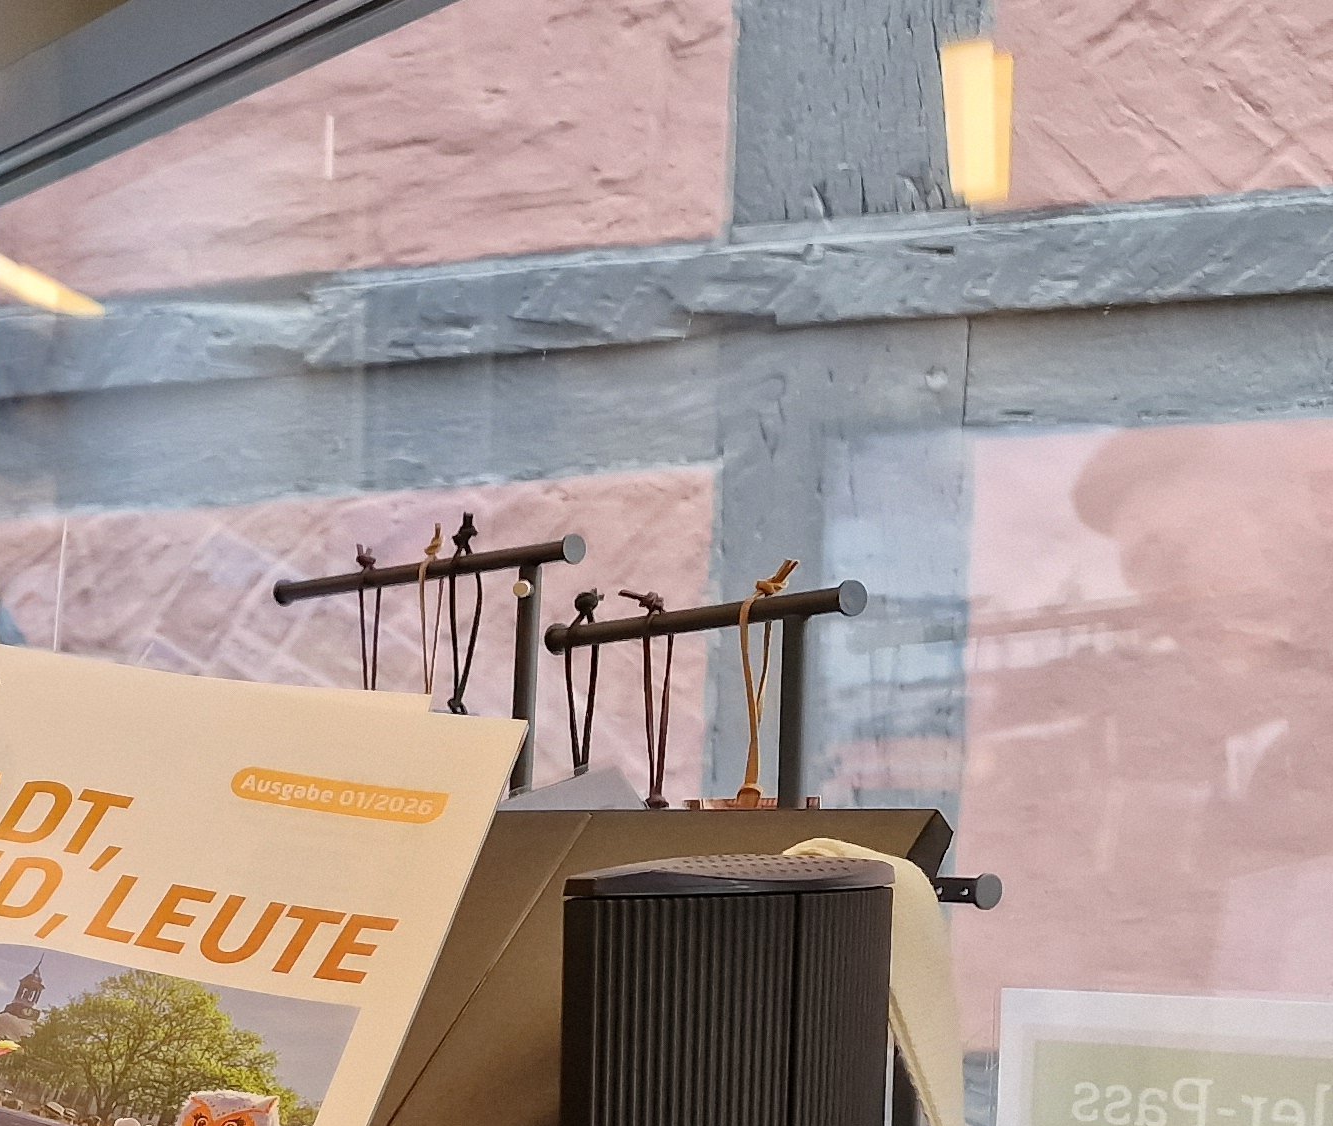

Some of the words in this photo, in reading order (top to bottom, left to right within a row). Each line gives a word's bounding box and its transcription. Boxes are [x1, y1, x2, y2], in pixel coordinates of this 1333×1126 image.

[240, 773, 334, 805] Ausgabe
[338, 786, 435, 817] 01/2026
[83, 874, 401, 985] LEUTE
